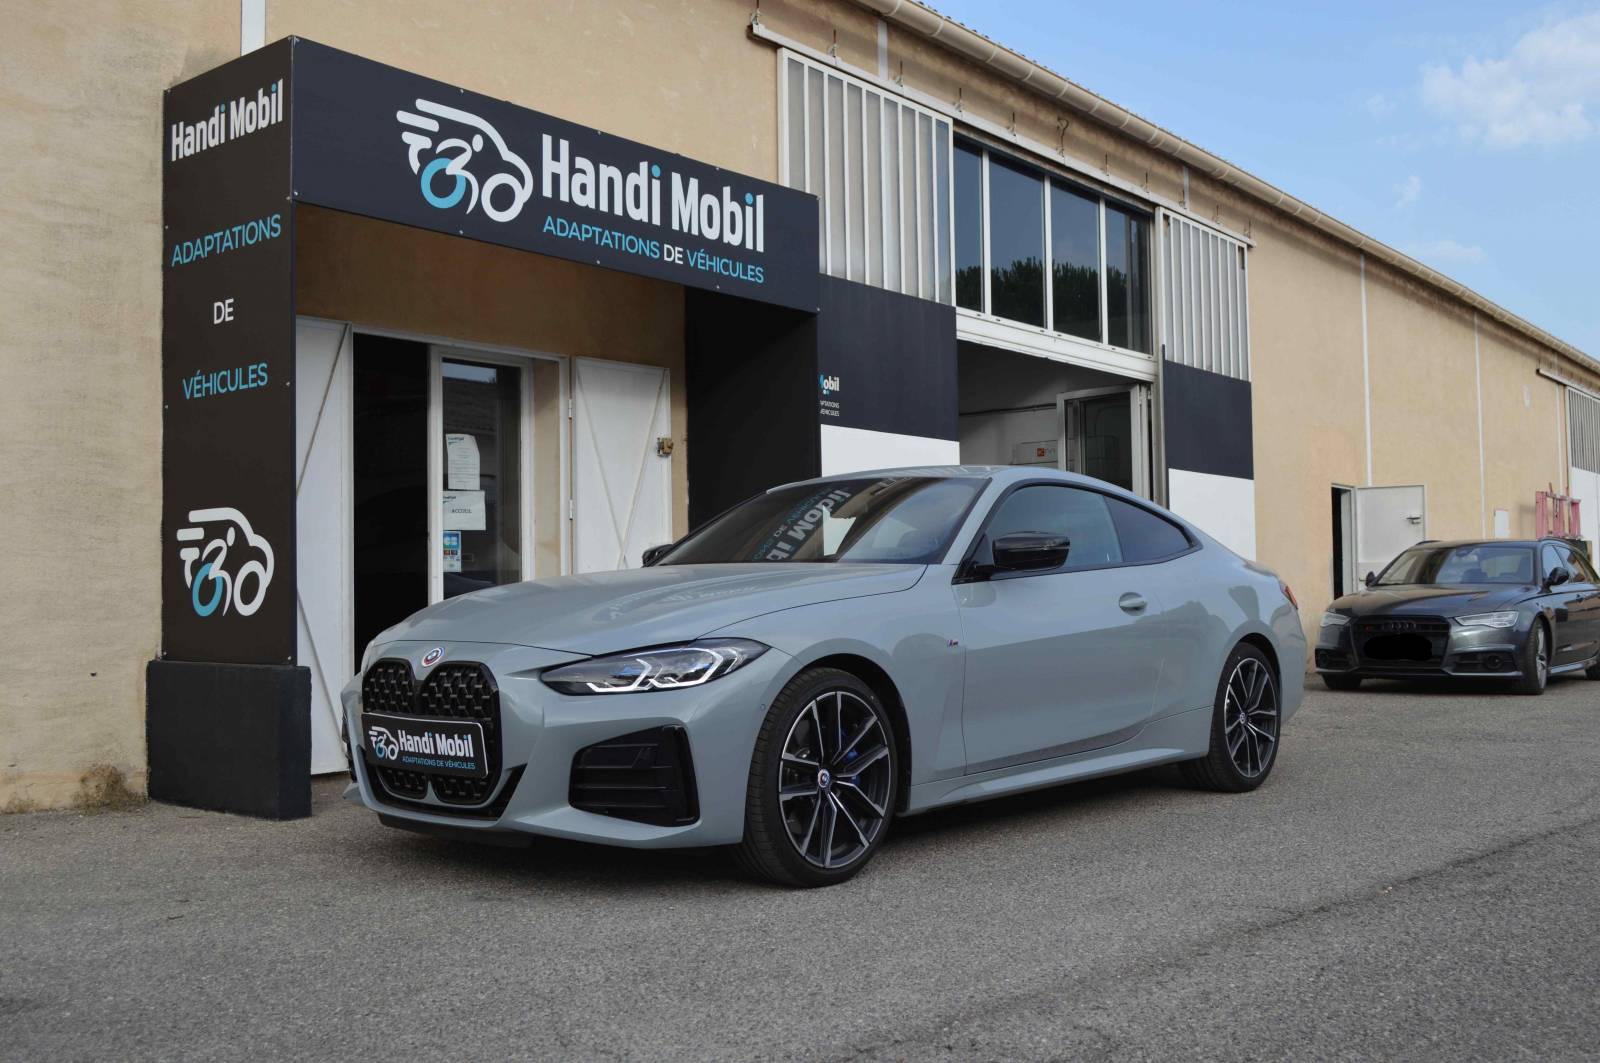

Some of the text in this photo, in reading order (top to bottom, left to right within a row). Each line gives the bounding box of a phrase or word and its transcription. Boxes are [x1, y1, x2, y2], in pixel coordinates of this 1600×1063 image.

[171, 78, 283, 161] Handi Mobil
[542, 133, 764, 253] Handi Mobil
[171, 214, 281, 266] ADAPTATIONS
[543, 216, 764, 284] ADAPTATIONS DE VÉHICULES
[213, 299, 234, 324] DE
[182, 362, 268, 399] VÉHICULES
[398, 730, 474, 758] Handi Mobil
[402, 756, 436, 767] ADAPTATIONS
[445, 760, 476, 770] VÉHICULES
